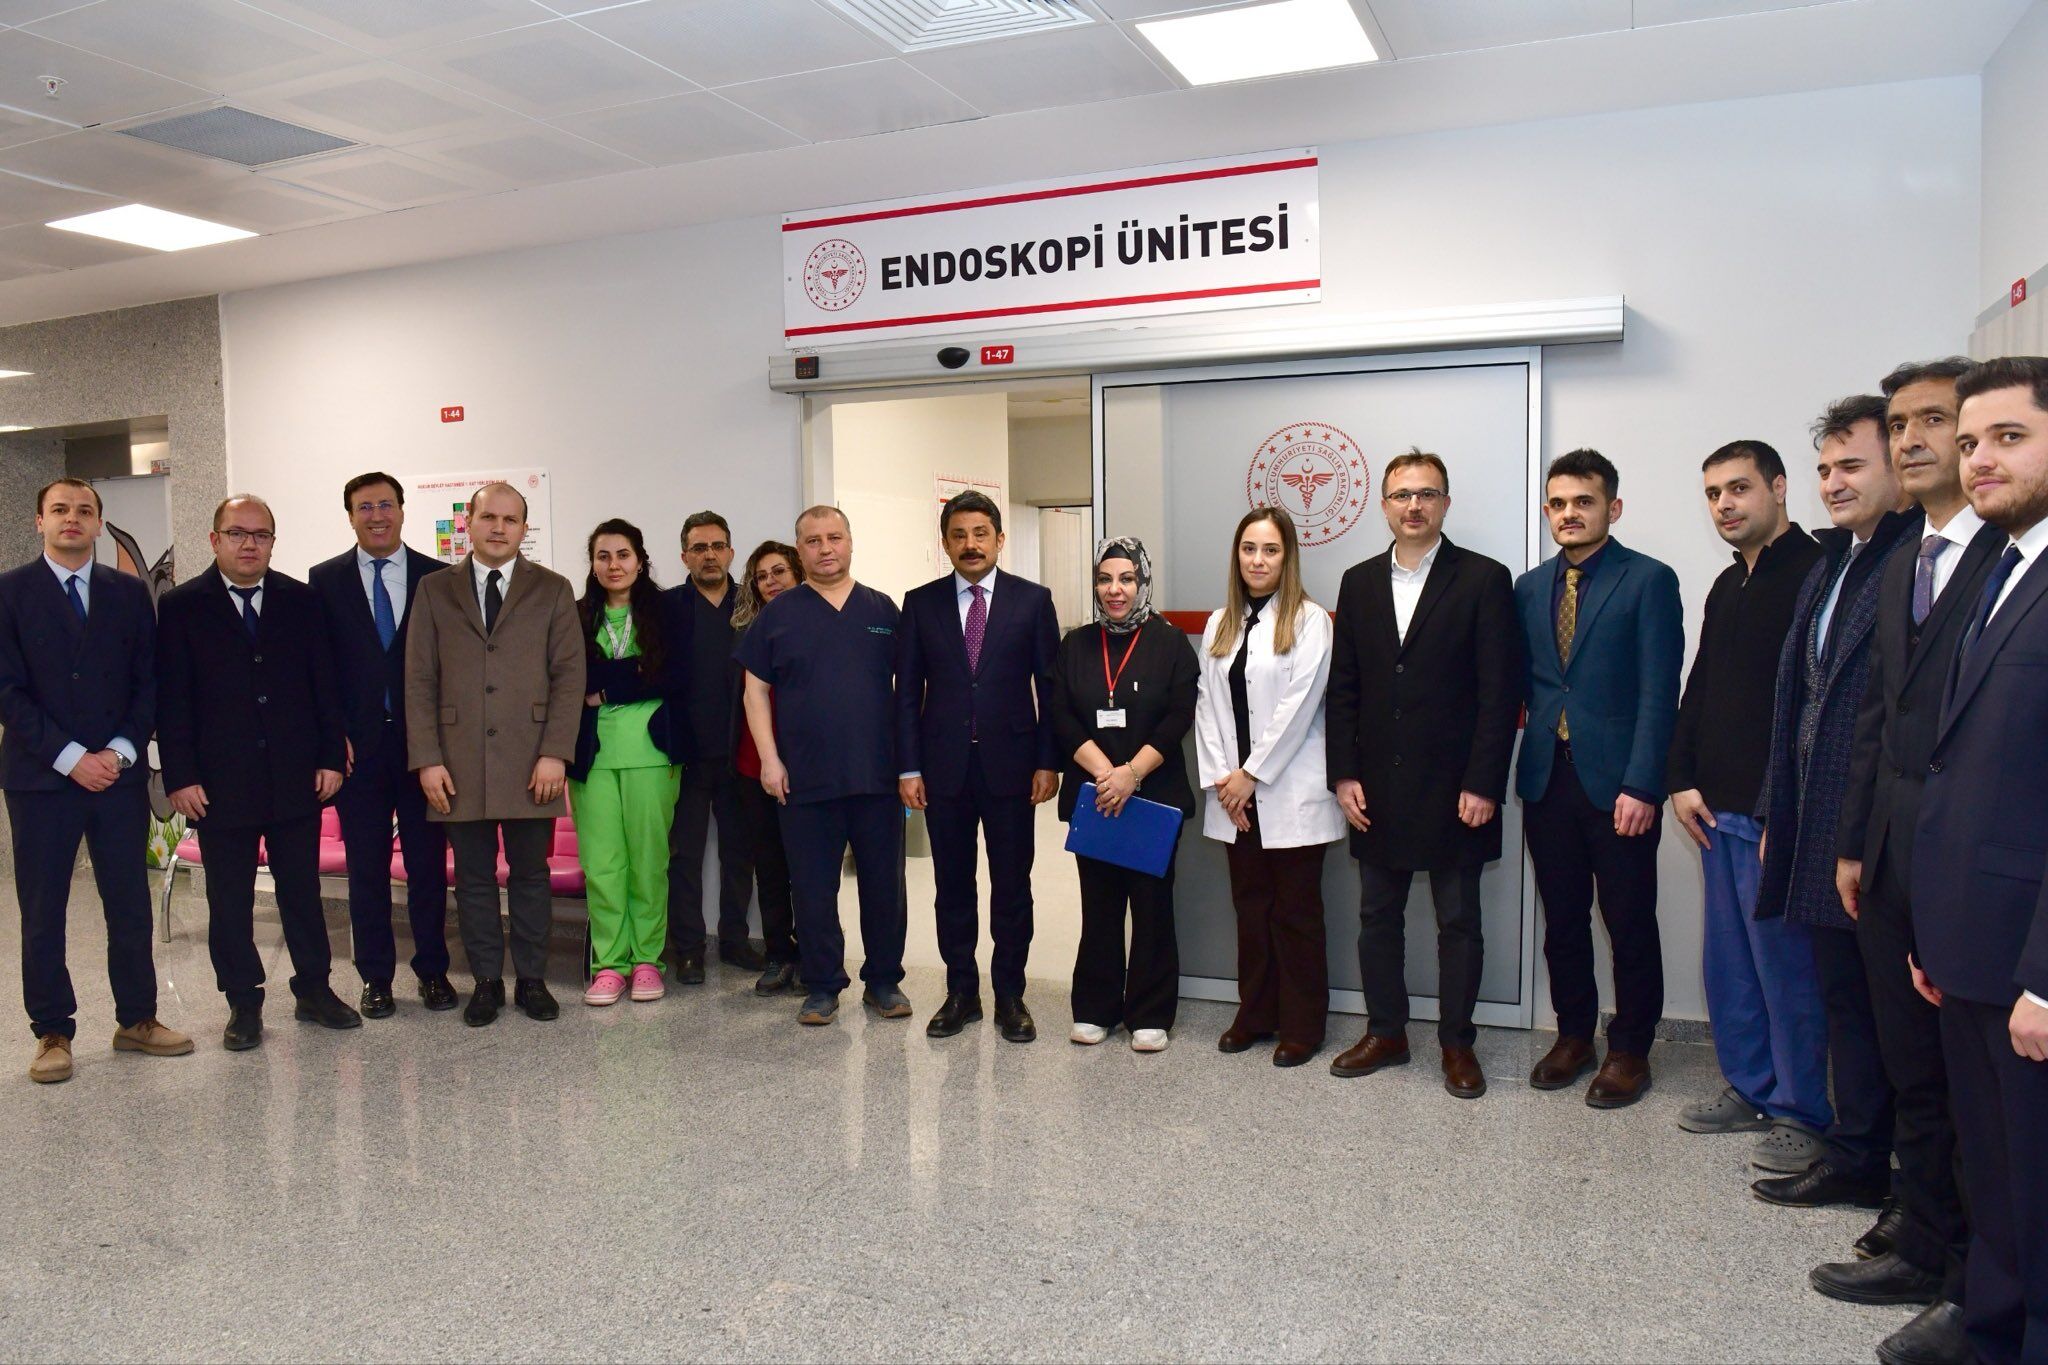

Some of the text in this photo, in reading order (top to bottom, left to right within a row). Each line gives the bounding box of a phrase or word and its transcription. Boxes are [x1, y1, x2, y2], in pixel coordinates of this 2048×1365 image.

[881, 223, 1104, 291] ENDOSKOPİ
[1117, 202, 1289, 265] ÜNİTESİ
[985, 349, 1009, 361] 1-47
[444, 409, 461, 419] 1-44
[1269, 444, 1316, 483] CUMHURİYETİ
[1317, 445, 1342, 471] SAĞLIK
[1325, 471, 1348, 518] BAKANLIĞI
